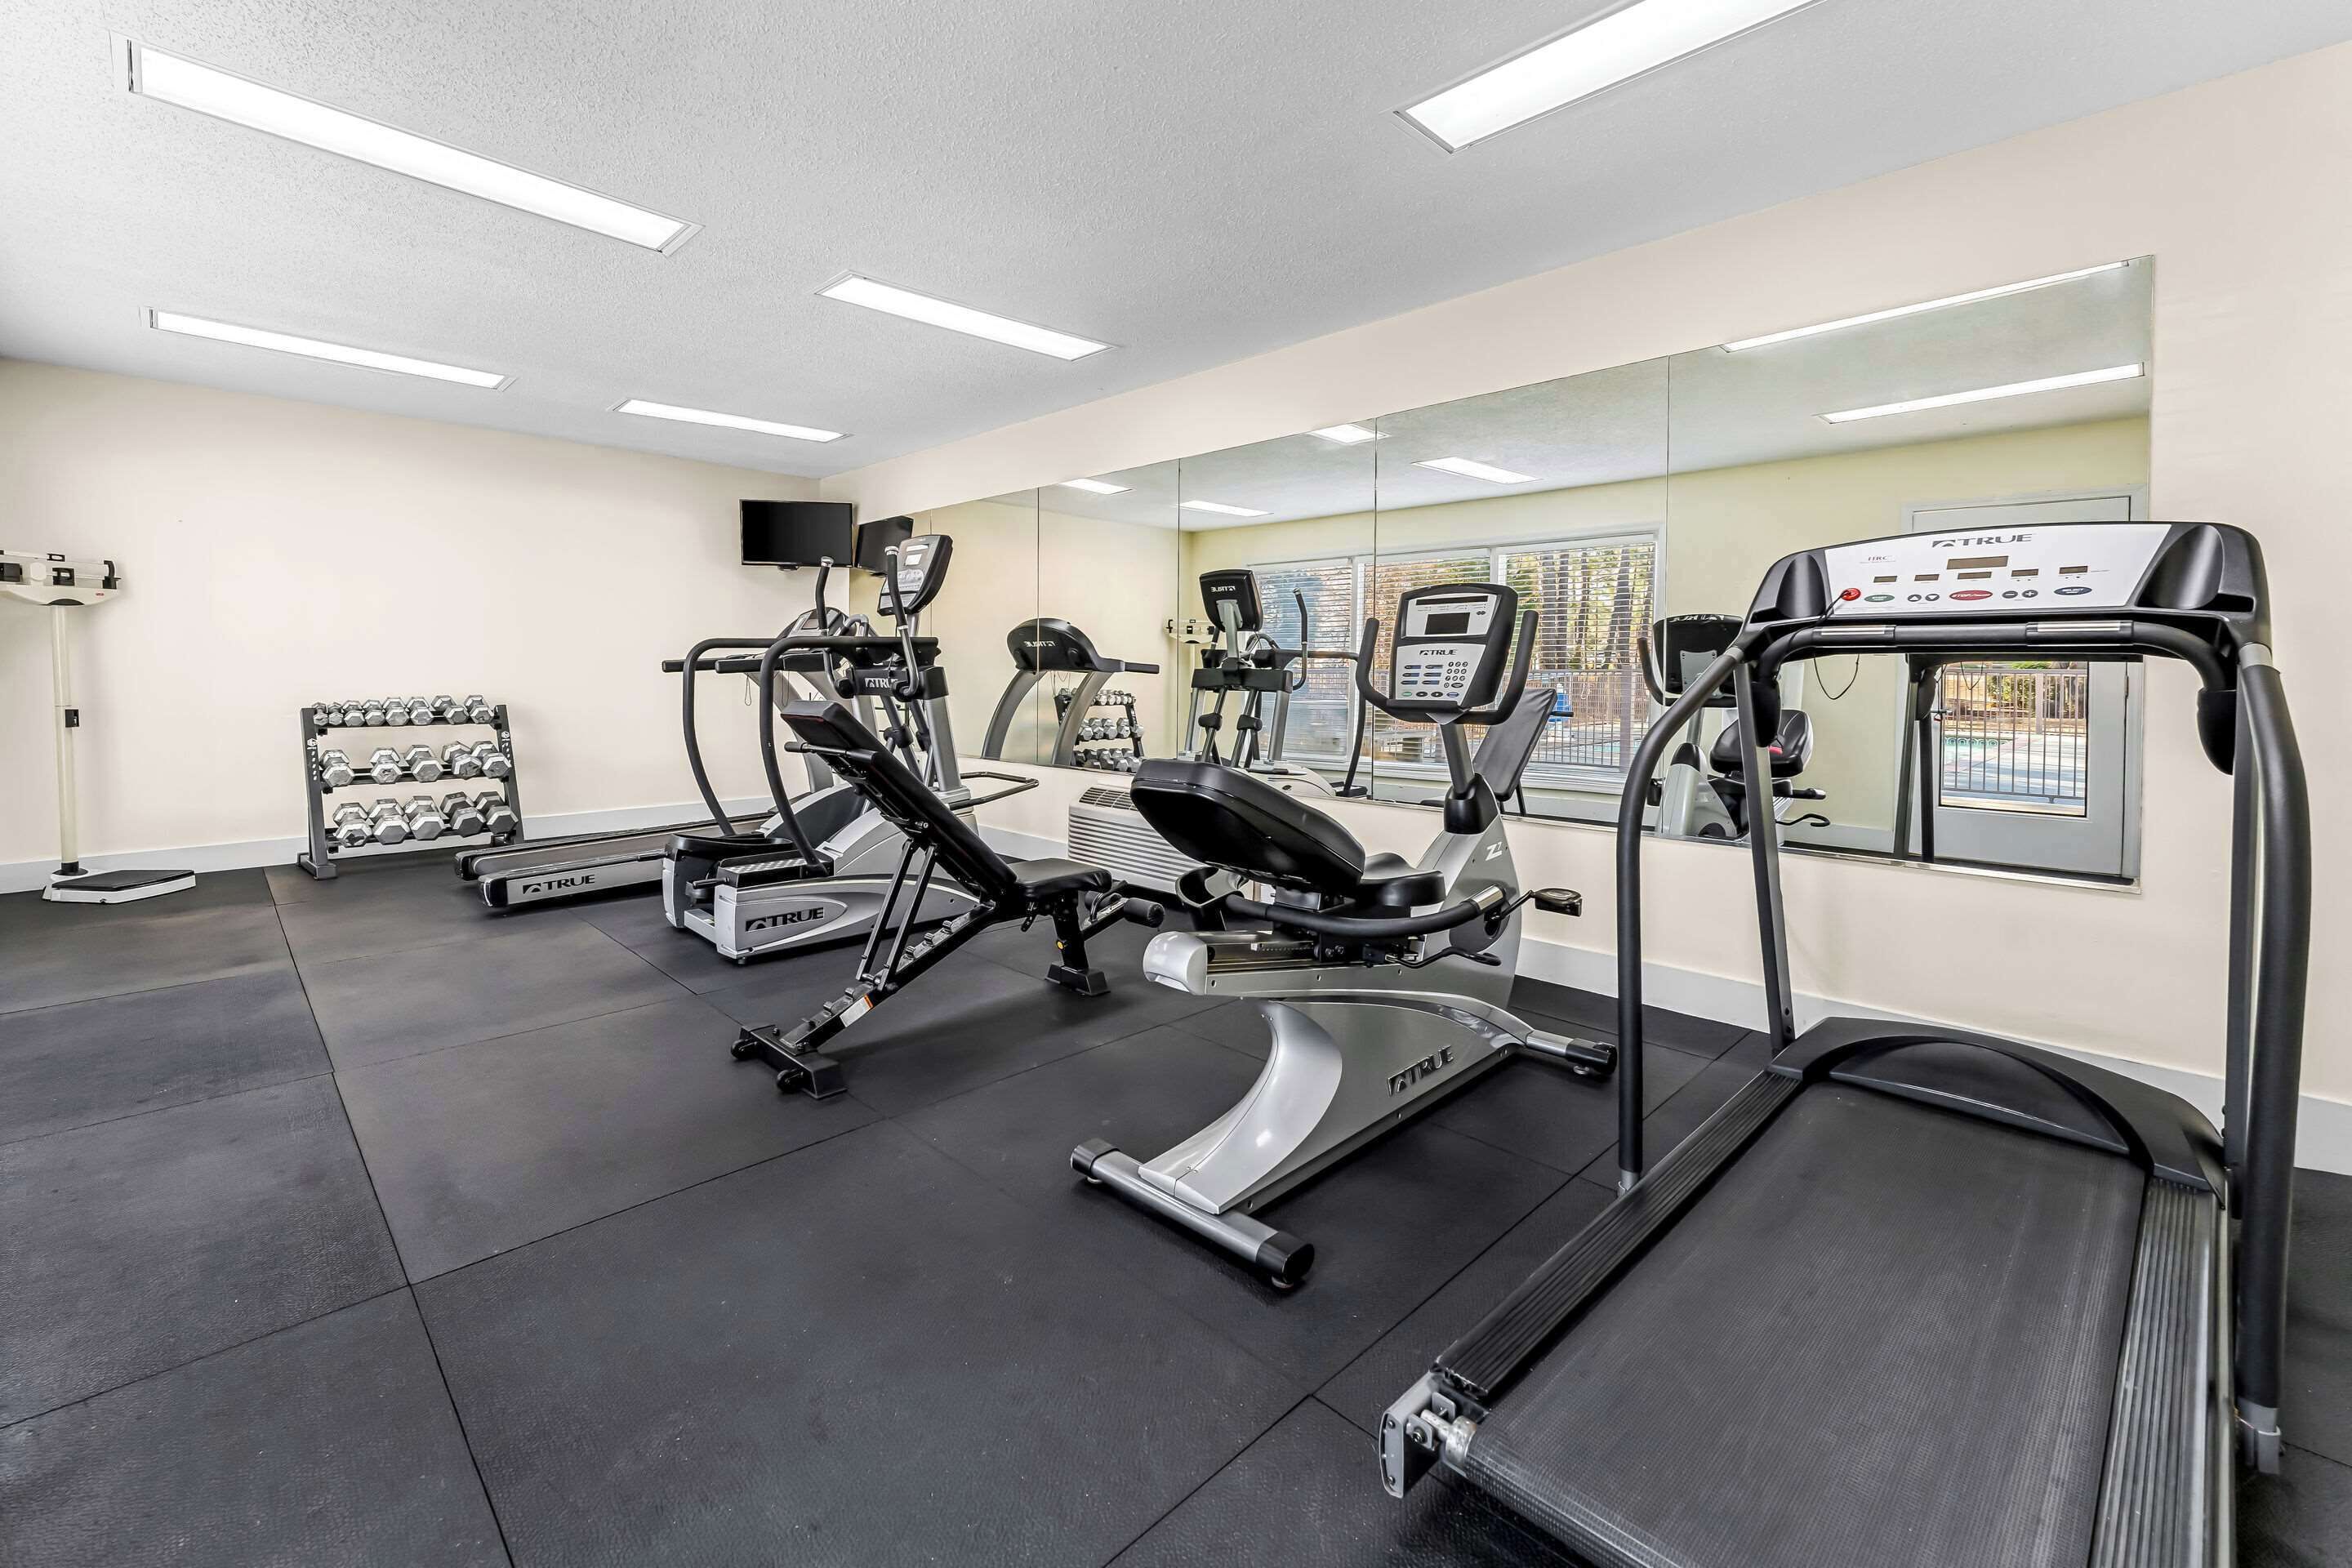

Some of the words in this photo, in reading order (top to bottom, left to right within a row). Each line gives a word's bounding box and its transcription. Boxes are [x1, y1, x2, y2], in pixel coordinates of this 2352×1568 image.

[1957, 532, 2034, 546] TRUE
[542, 874, 595, 890] TRUE
[767, 906, 824, 927] TRUE
[1405, 1045, 1454, 1085] TRUE
